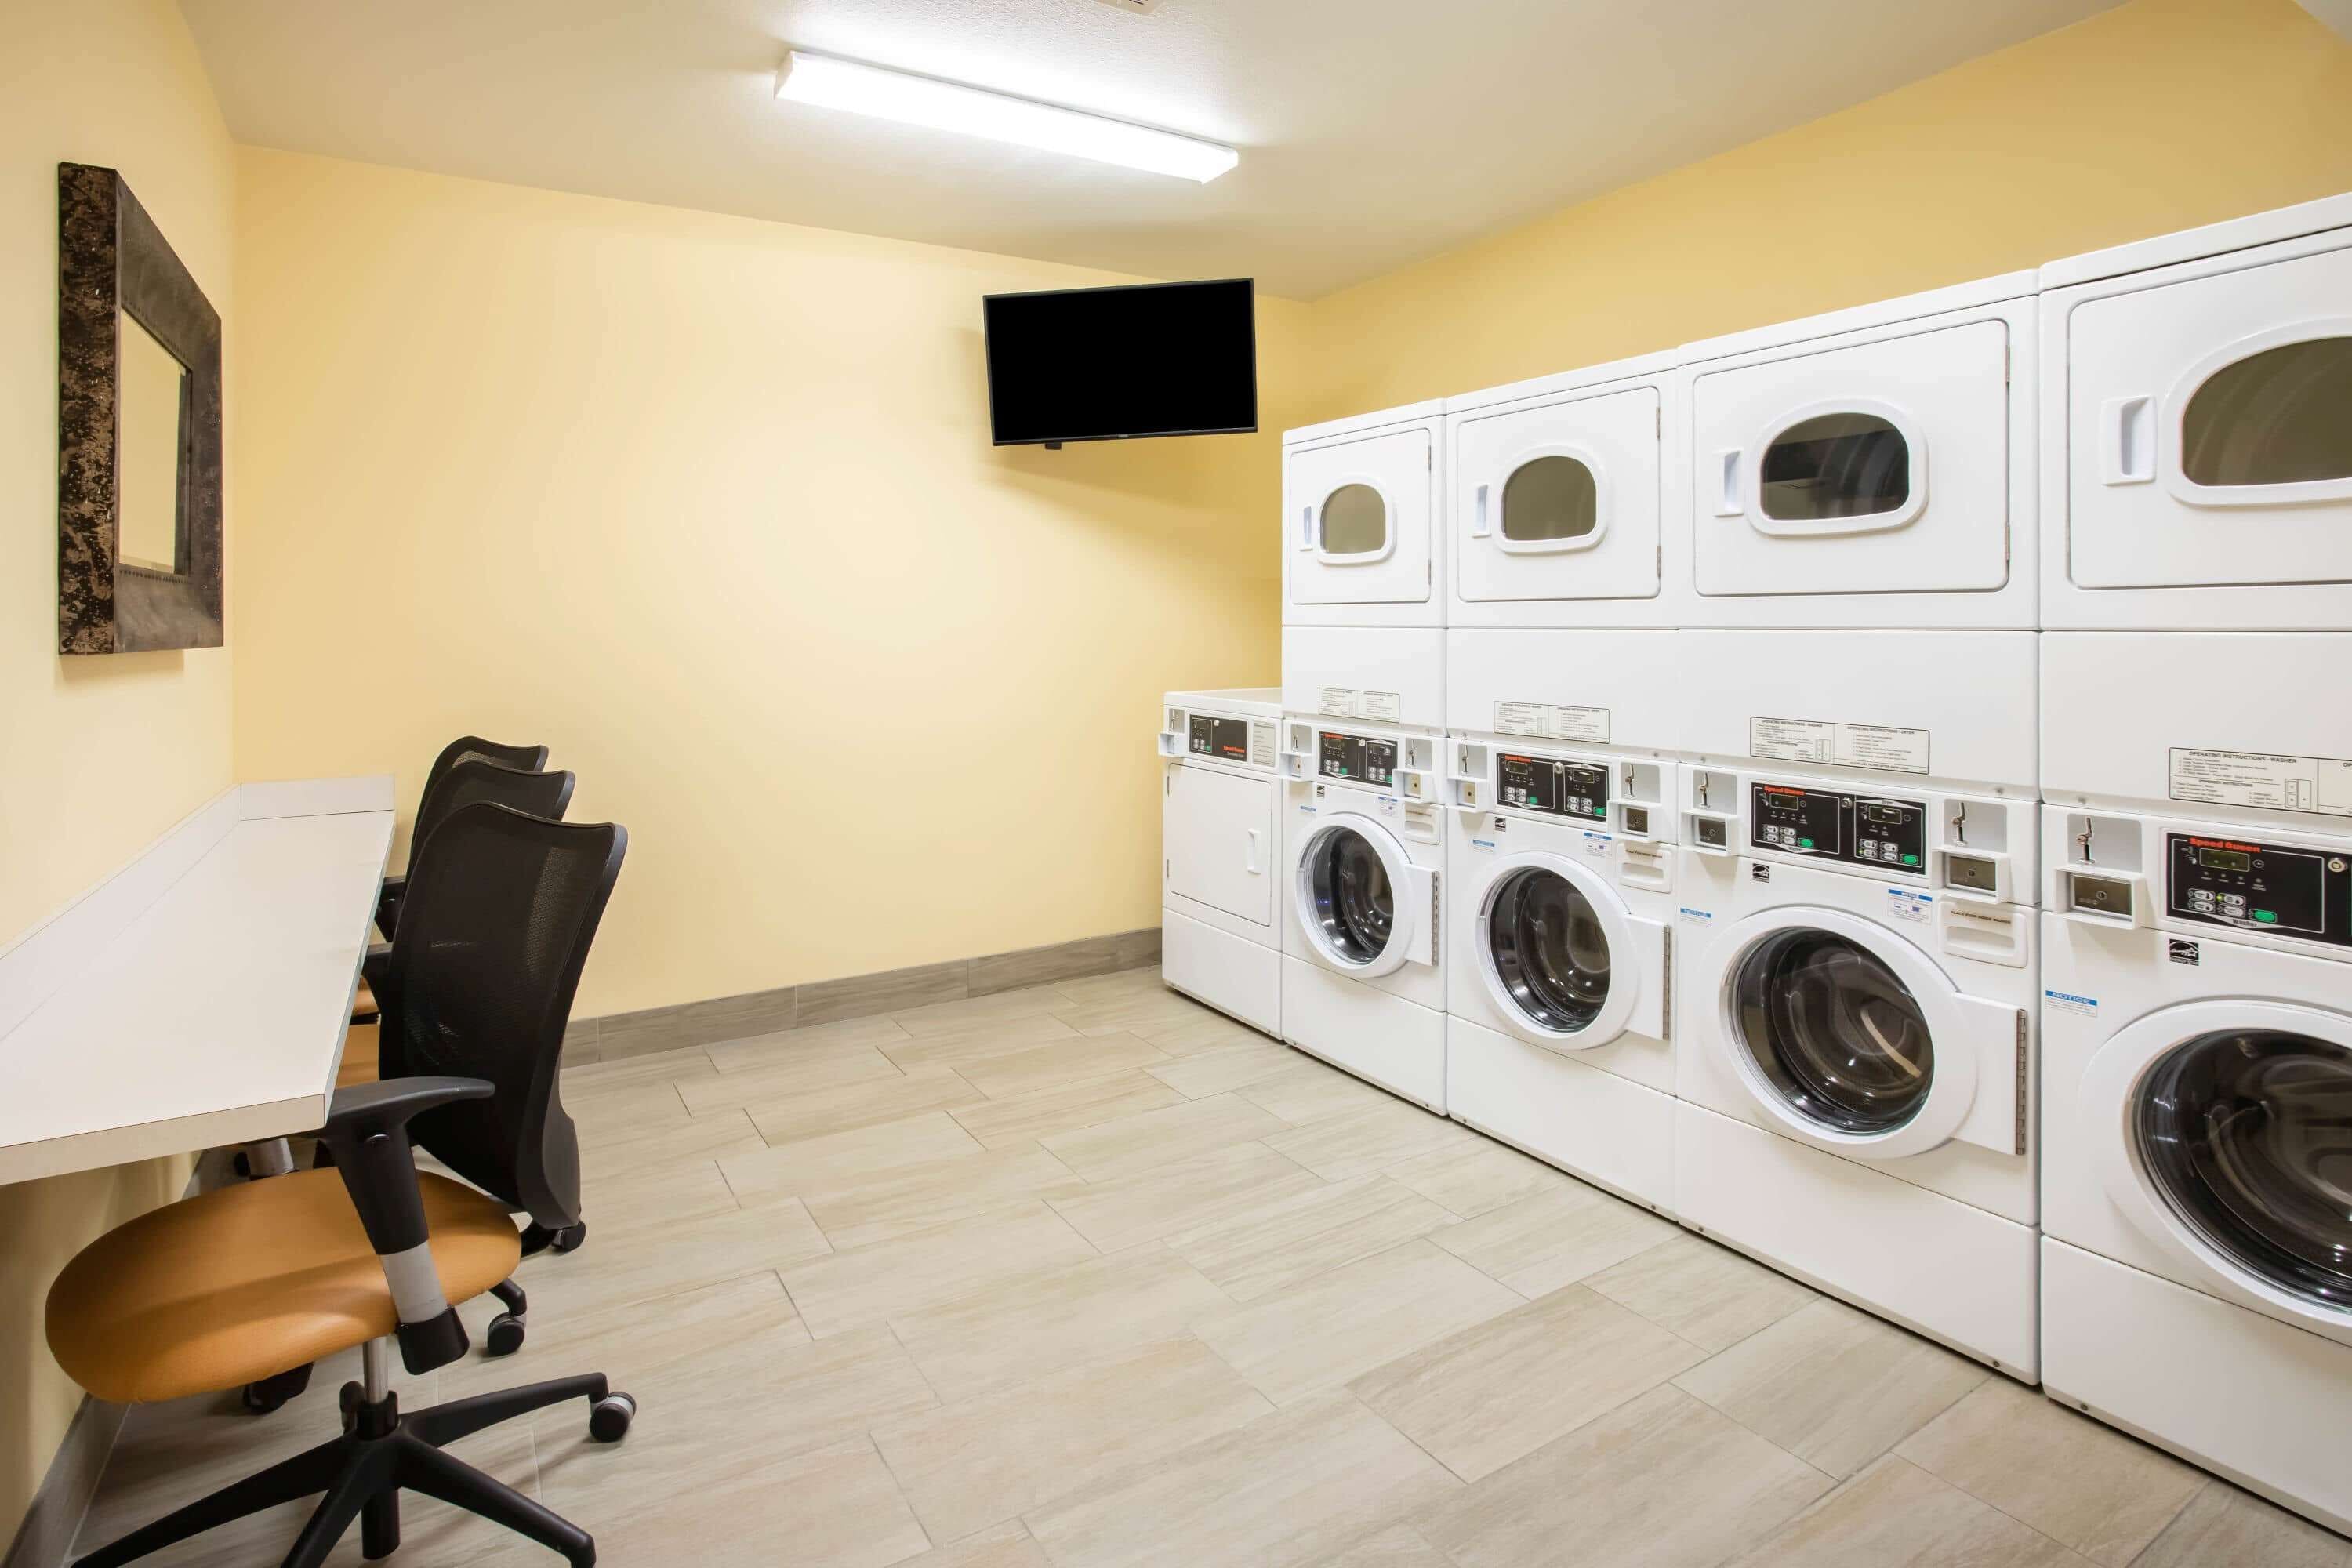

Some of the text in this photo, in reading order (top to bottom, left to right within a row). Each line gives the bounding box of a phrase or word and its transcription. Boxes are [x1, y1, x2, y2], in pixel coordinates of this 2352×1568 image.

[2222, 753, 2266, 761] INSTRUCTIONS
[2190, 837, 2262, 853] Speed Queen
[2232, 918, 2258, 927] Washer
[2053, 992, 2090, 1004] NOTICE
